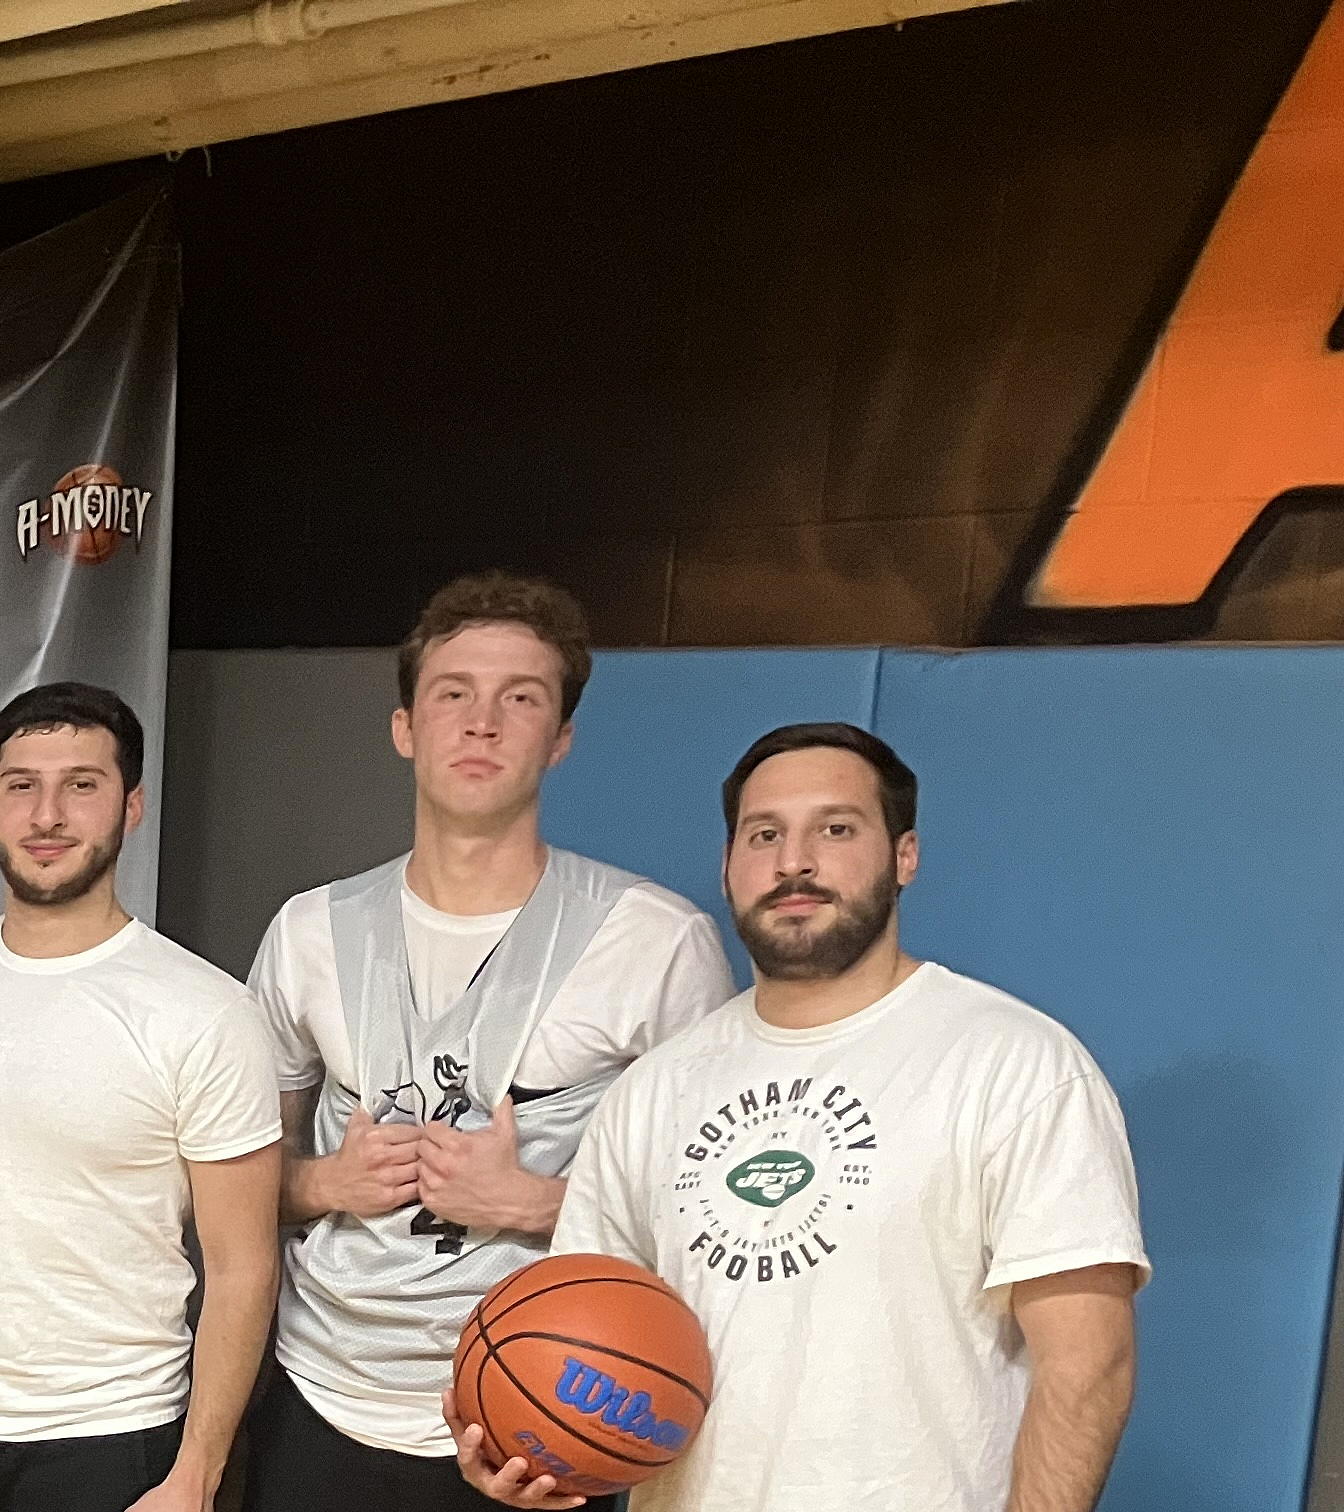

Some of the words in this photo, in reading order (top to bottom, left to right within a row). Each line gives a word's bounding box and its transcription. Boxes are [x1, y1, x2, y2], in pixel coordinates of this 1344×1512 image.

[17, 486, 152, 557] A-MONEY
[823, 1085, 877, 1150] CITY
[555, 1355, 690, 1451] Wils
